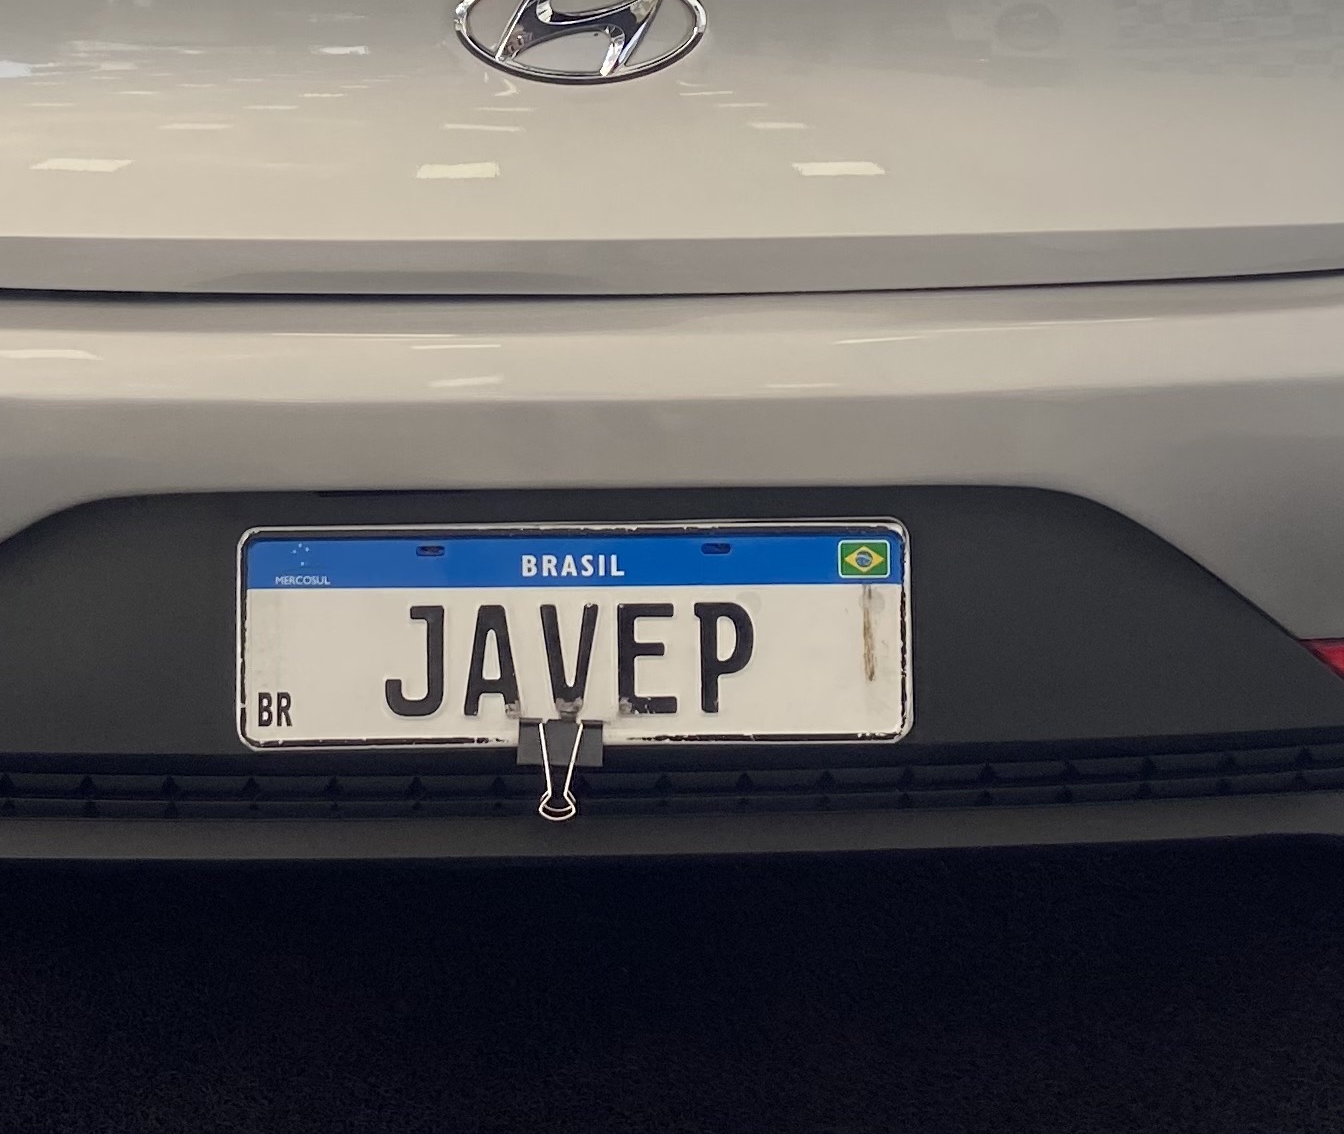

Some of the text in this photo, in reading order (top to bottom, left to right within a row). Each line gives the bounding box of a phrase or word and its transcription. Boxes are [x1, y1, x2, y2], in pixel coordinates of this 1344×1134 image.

[274, 575, 331, 585] MERCOSUL
[521, 554, 625, 577] BRASIL
[384, 602, 755, 717] JAVEP
[257, 692, 292, 727] BR
